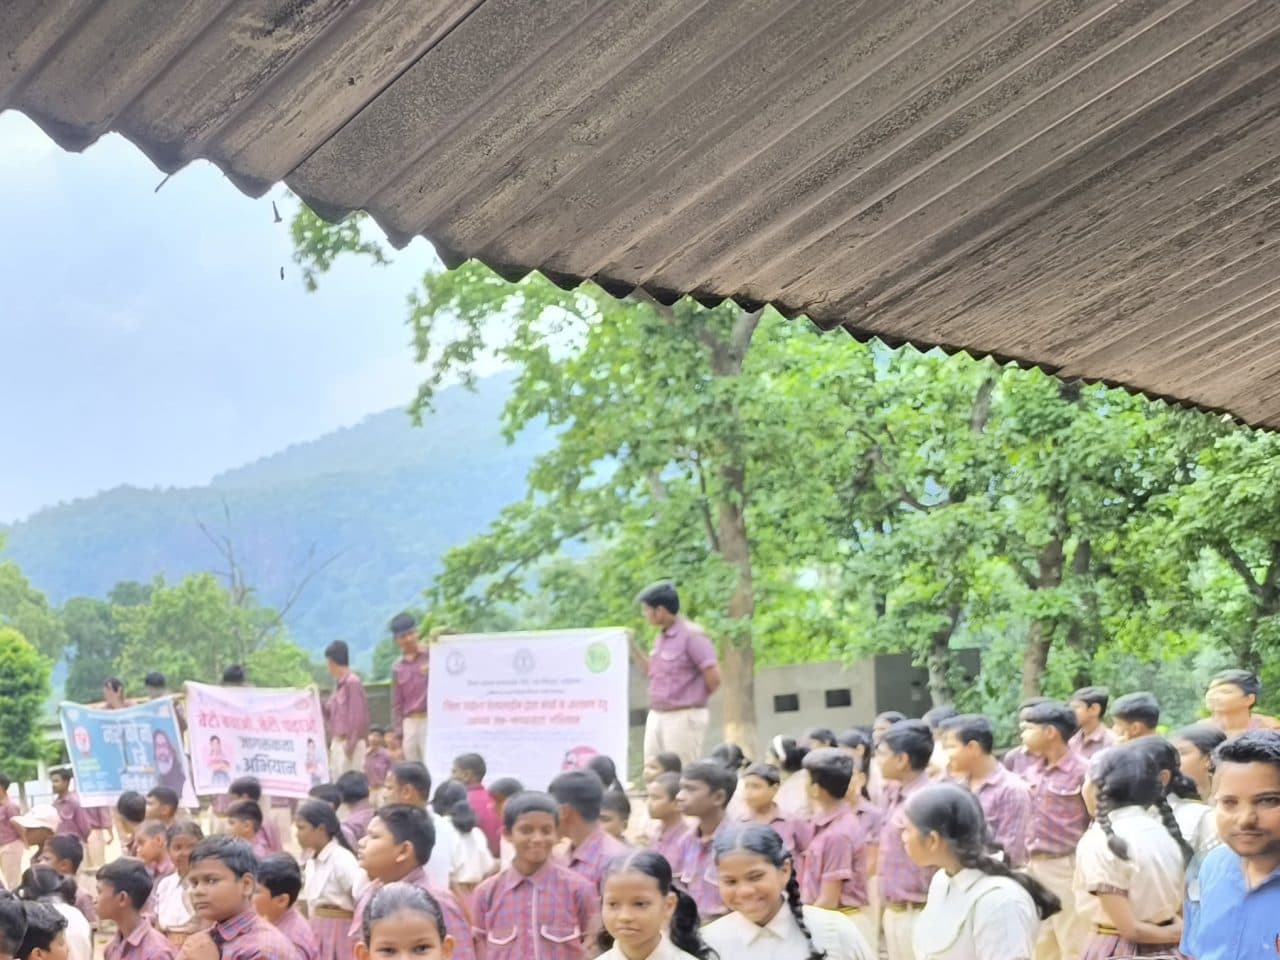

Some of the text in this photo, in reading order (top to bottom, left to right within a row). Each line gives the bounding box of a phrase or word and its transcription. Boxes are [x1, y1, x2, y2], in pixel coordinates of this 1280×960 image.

[199, 710, 220, 728] बेटी
[259, 716, 280, 732] बेटी
[242, 754, 297, 775] अभियान
